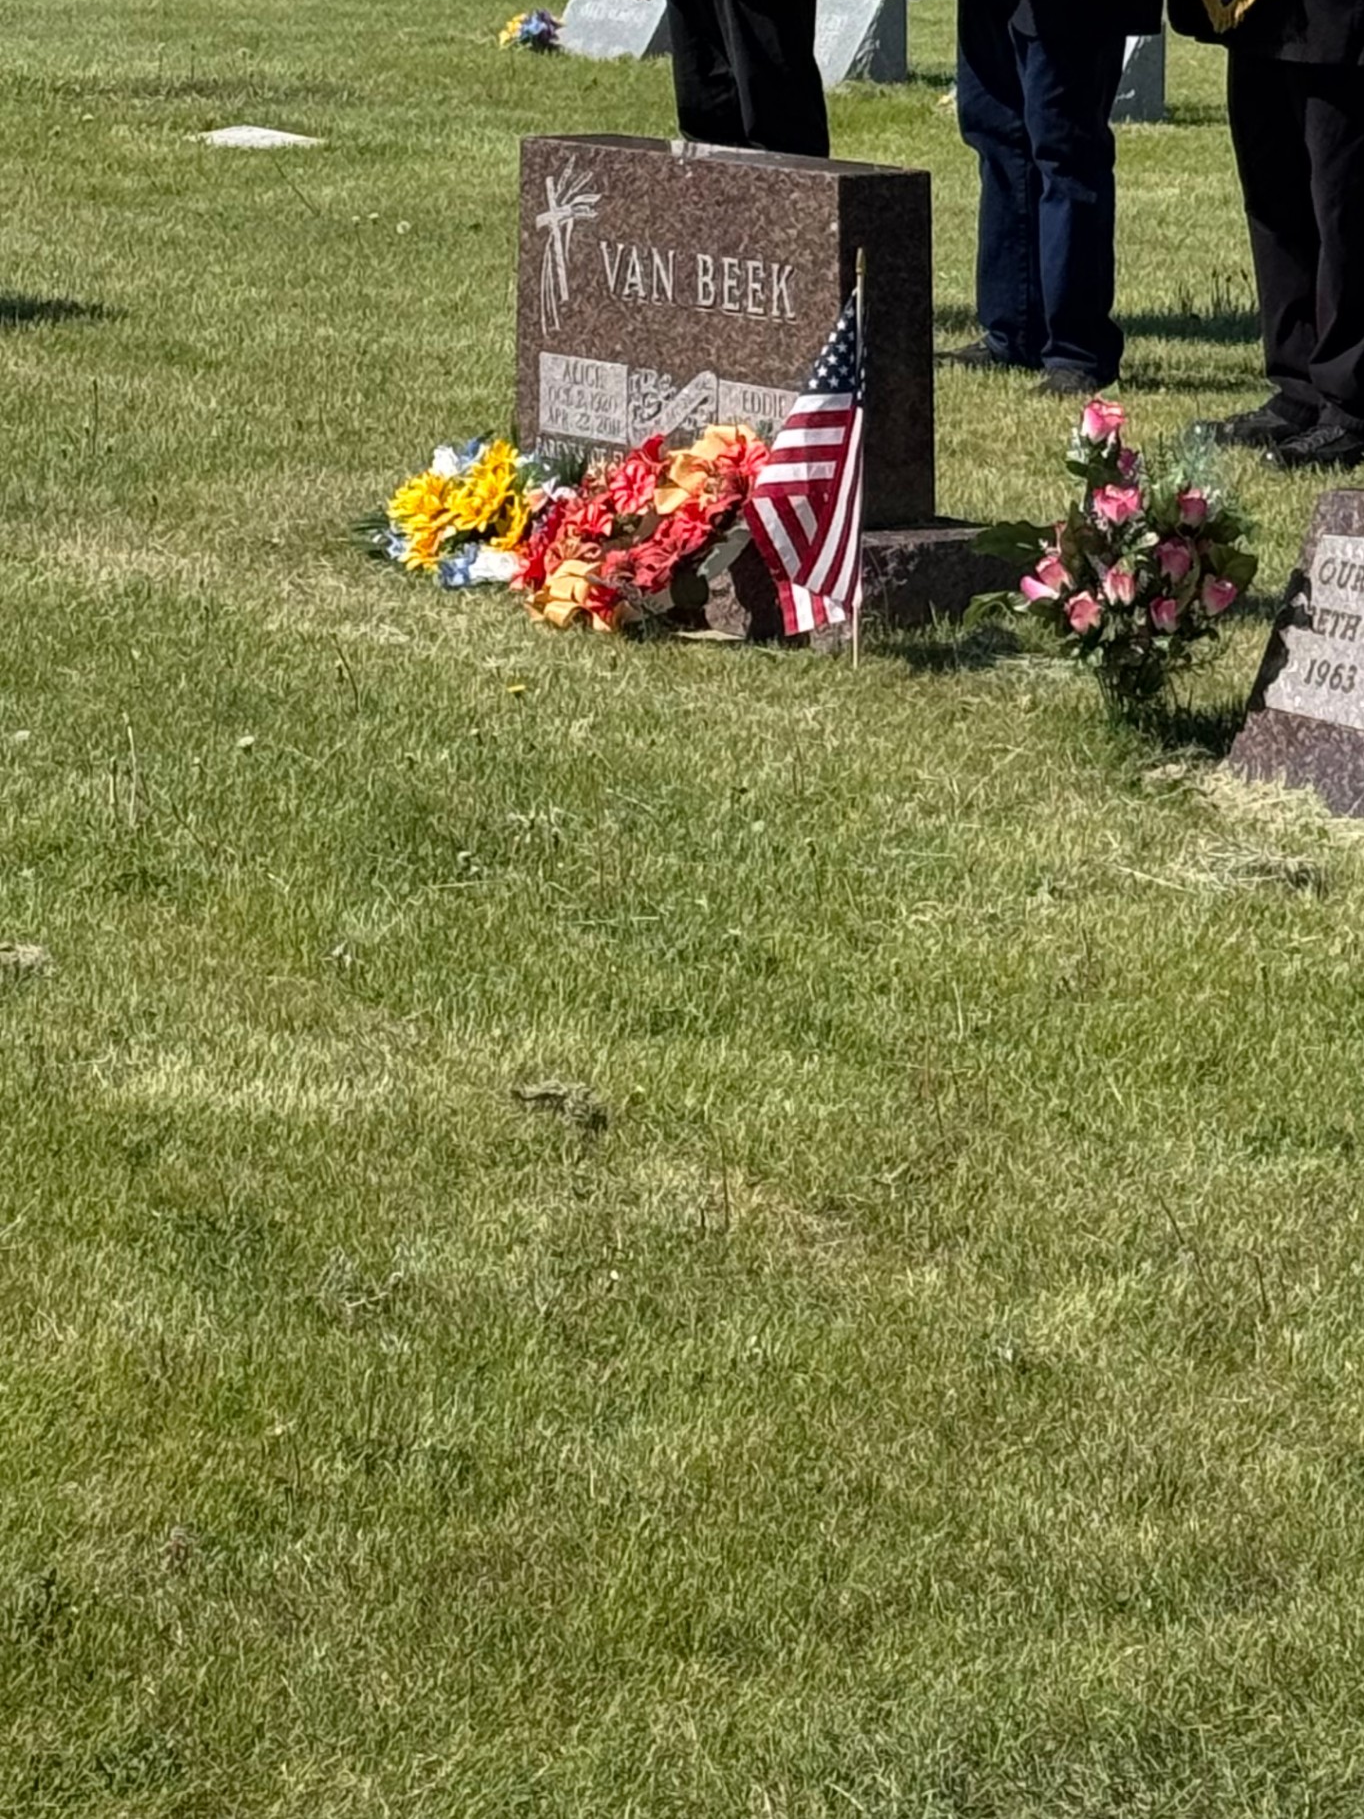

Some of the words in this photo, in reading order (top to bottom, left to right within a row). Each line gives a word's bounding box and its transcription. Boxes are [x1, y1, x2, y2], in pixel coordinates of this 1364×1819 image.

[601, 240, 676, 305] VAN
[696, 253, 798, 323] BEEK
[742, 390, 787, 419] EDDIE
[1304, 659, 1358, 694] 1963
